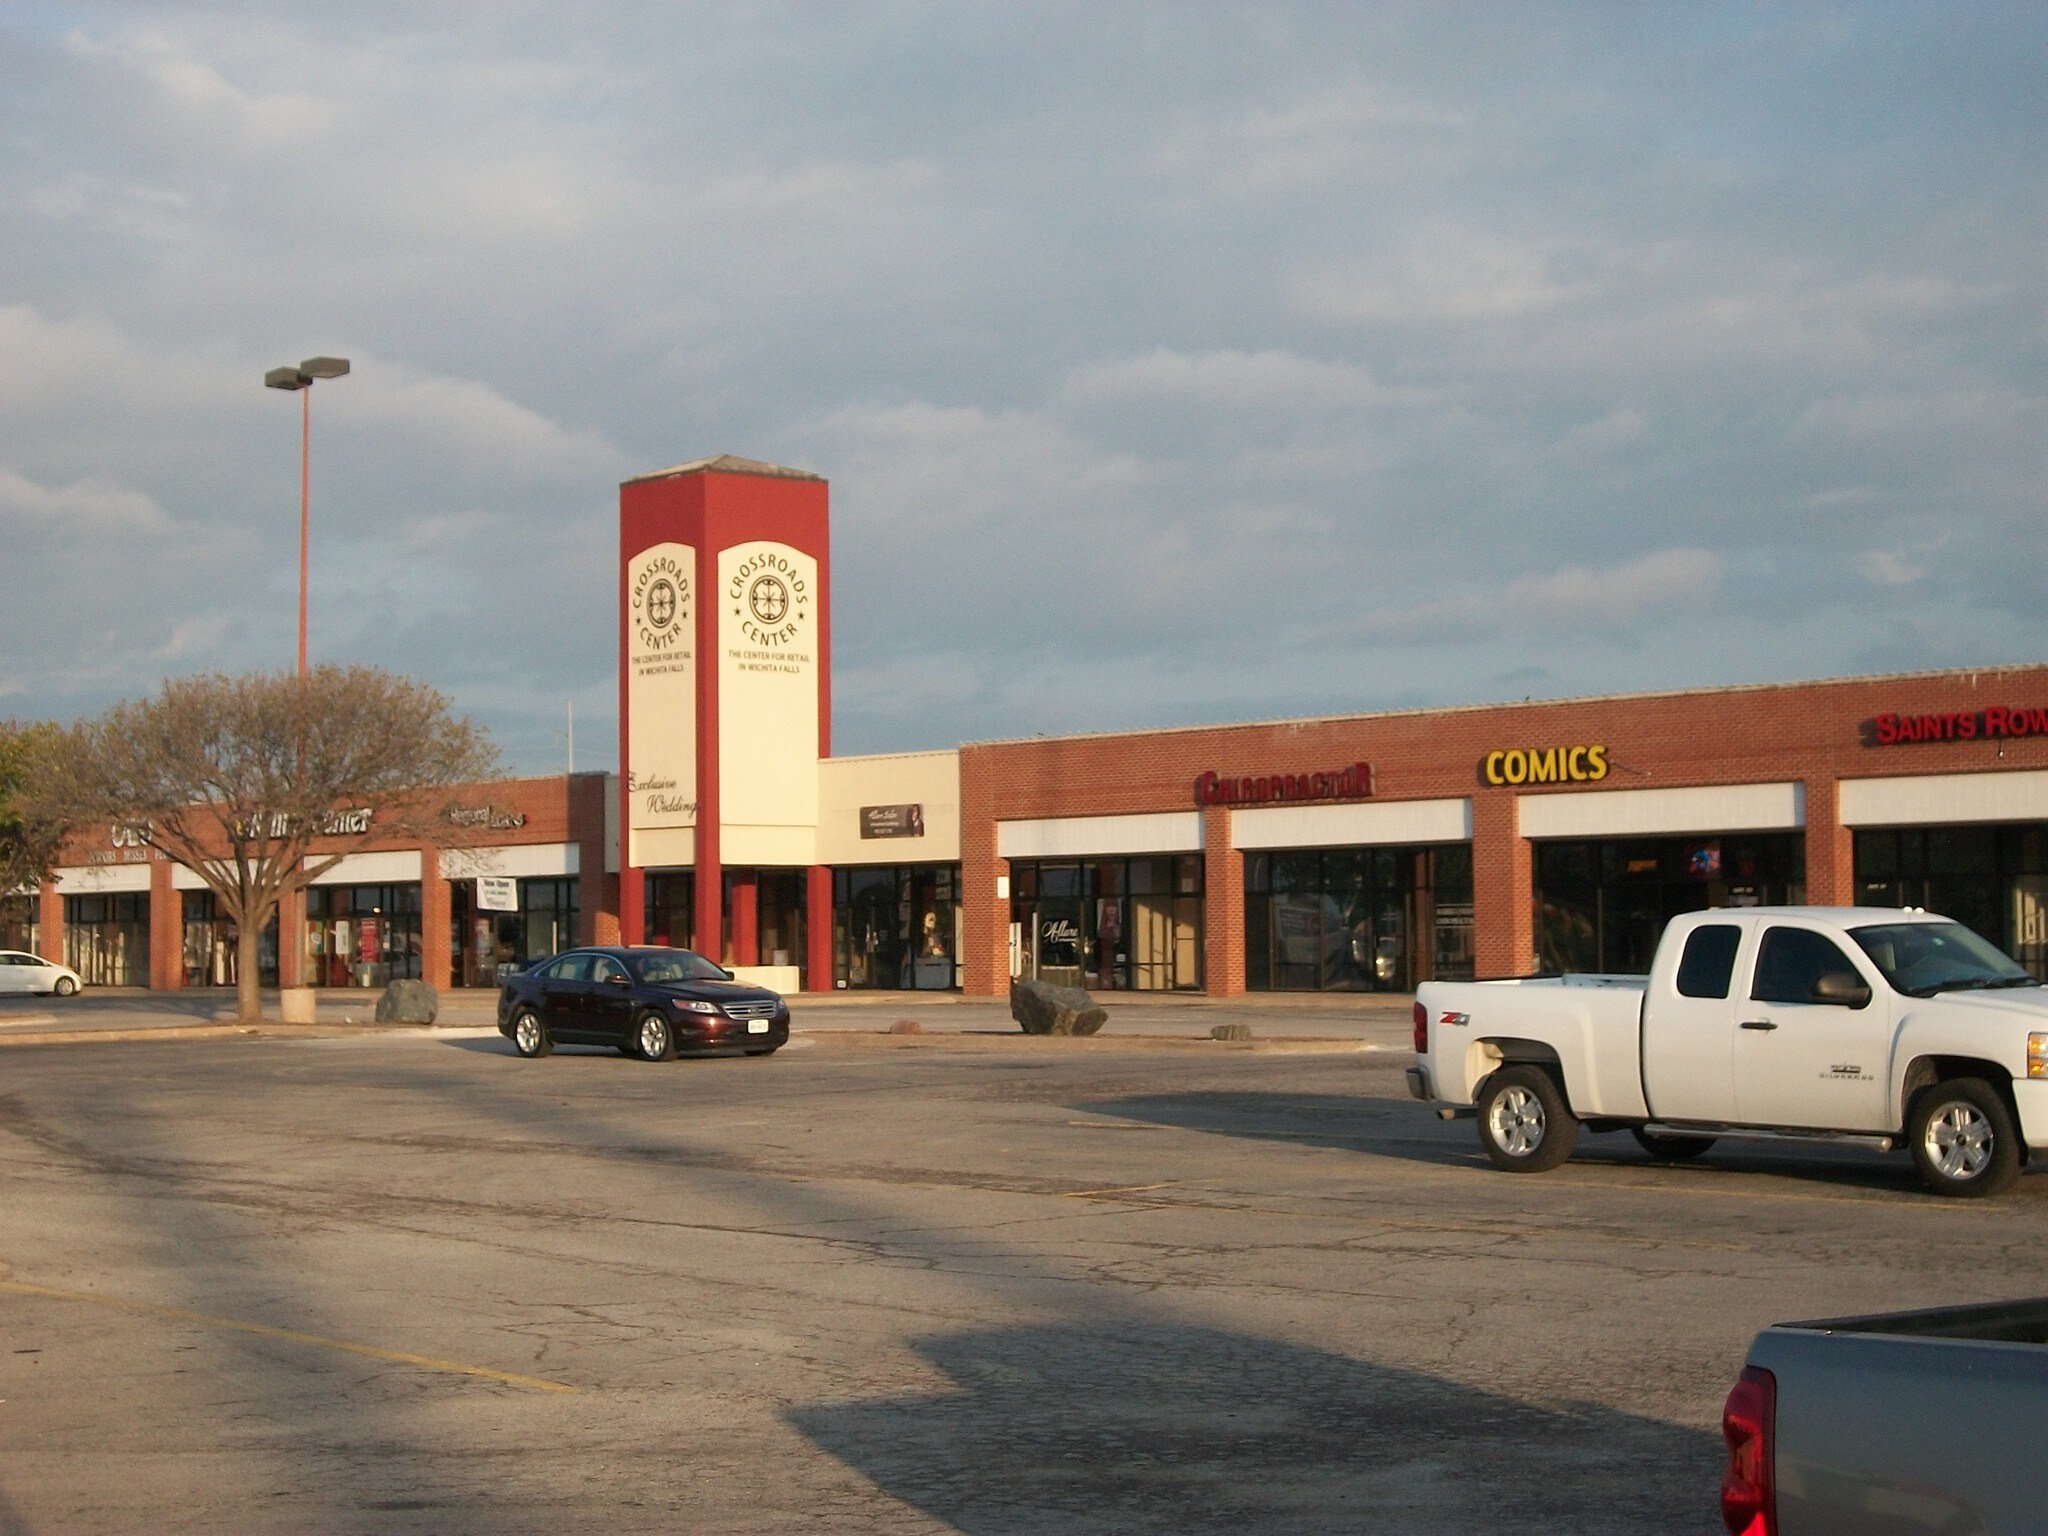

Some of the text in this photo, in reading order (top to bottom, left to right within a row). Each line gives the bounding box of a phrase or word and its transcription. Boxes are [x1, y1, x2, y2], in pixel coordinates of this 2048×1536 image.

[633, 557, 691, 609] CROSSROADS
[730, 553, 808, 604] CROSSROADS
[640, 622, 682, 650] CENTER
[742, 621, 798, 646] CENTER
[728, 650, 810, 662] THE CENTER FOR RETAIL
[738, 663, 800, 673] IN WICHITA FALLS
[1876, 704, 2048, 745] SAINTS ROW
[628, 771, 677, 793] Exclusive
[1485, 744, 1609, 786] COMICS
[1202, 761, 1374, 806] CHIROPRACTOR
